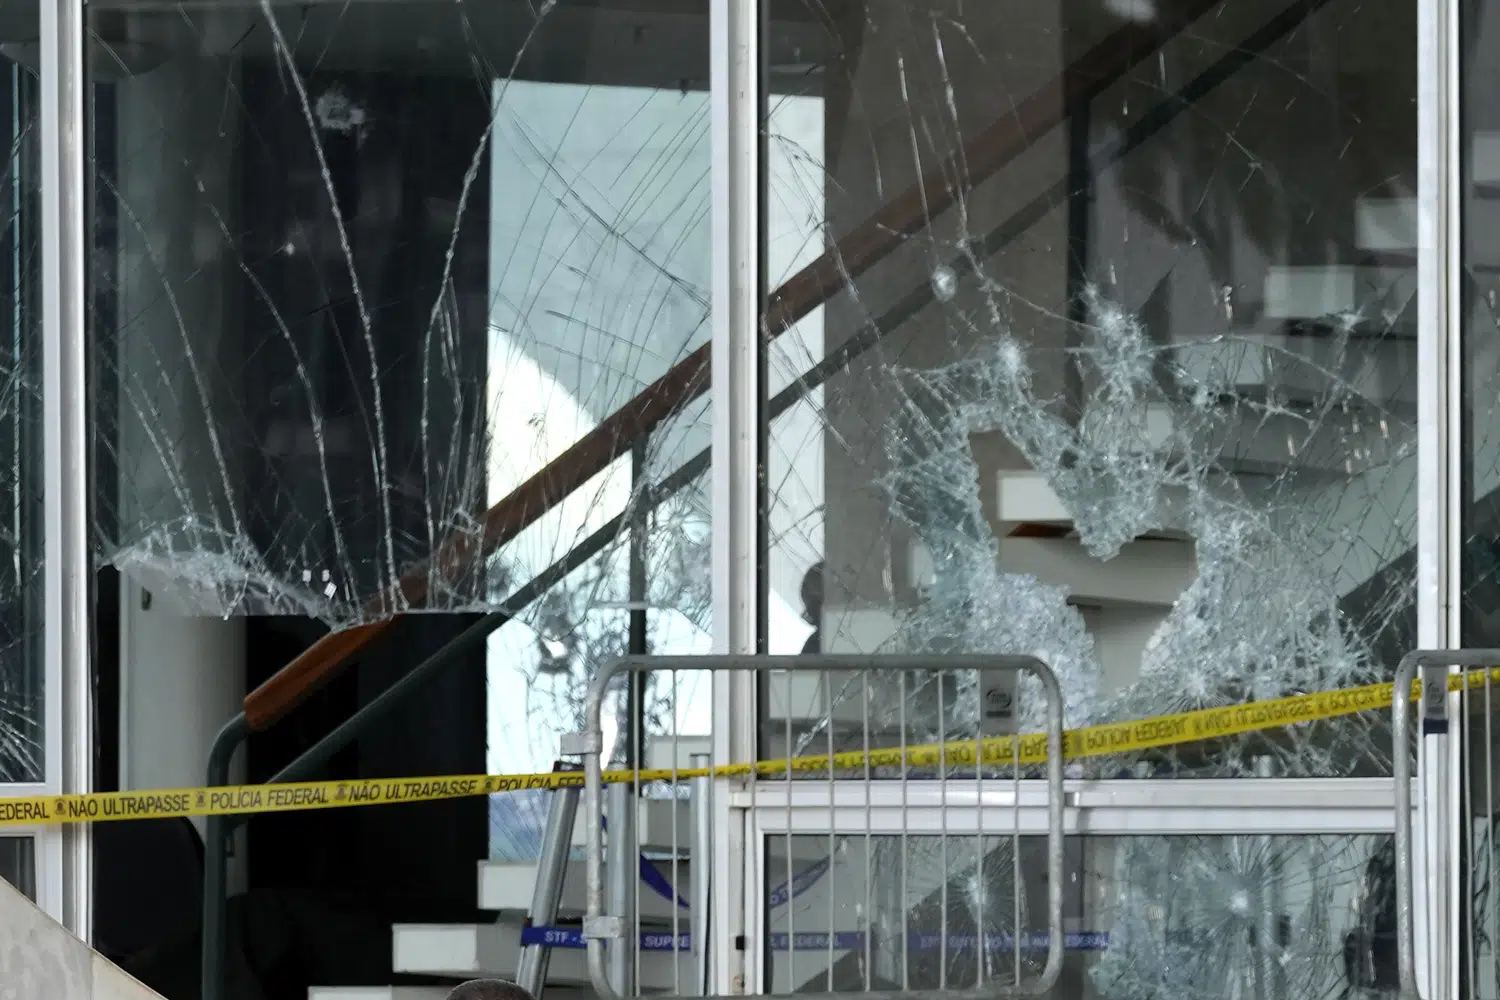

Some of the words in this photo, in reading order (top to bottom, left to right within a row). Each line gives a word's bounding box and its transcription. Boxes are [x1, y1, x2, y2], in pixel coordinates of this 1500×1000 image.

[69, 796, 98, 819] NÃO
[103, 794, 190, 816] ULTRAPASSE
[210, 787, 262, 810] POLÍCIA
[267, 786, 329, 807] FEDERAL
[349, 779, 380, 801] NÃO
[385, 779, 477, 800] ULTRAPASSE
[544, 930, 569, 944] STF
